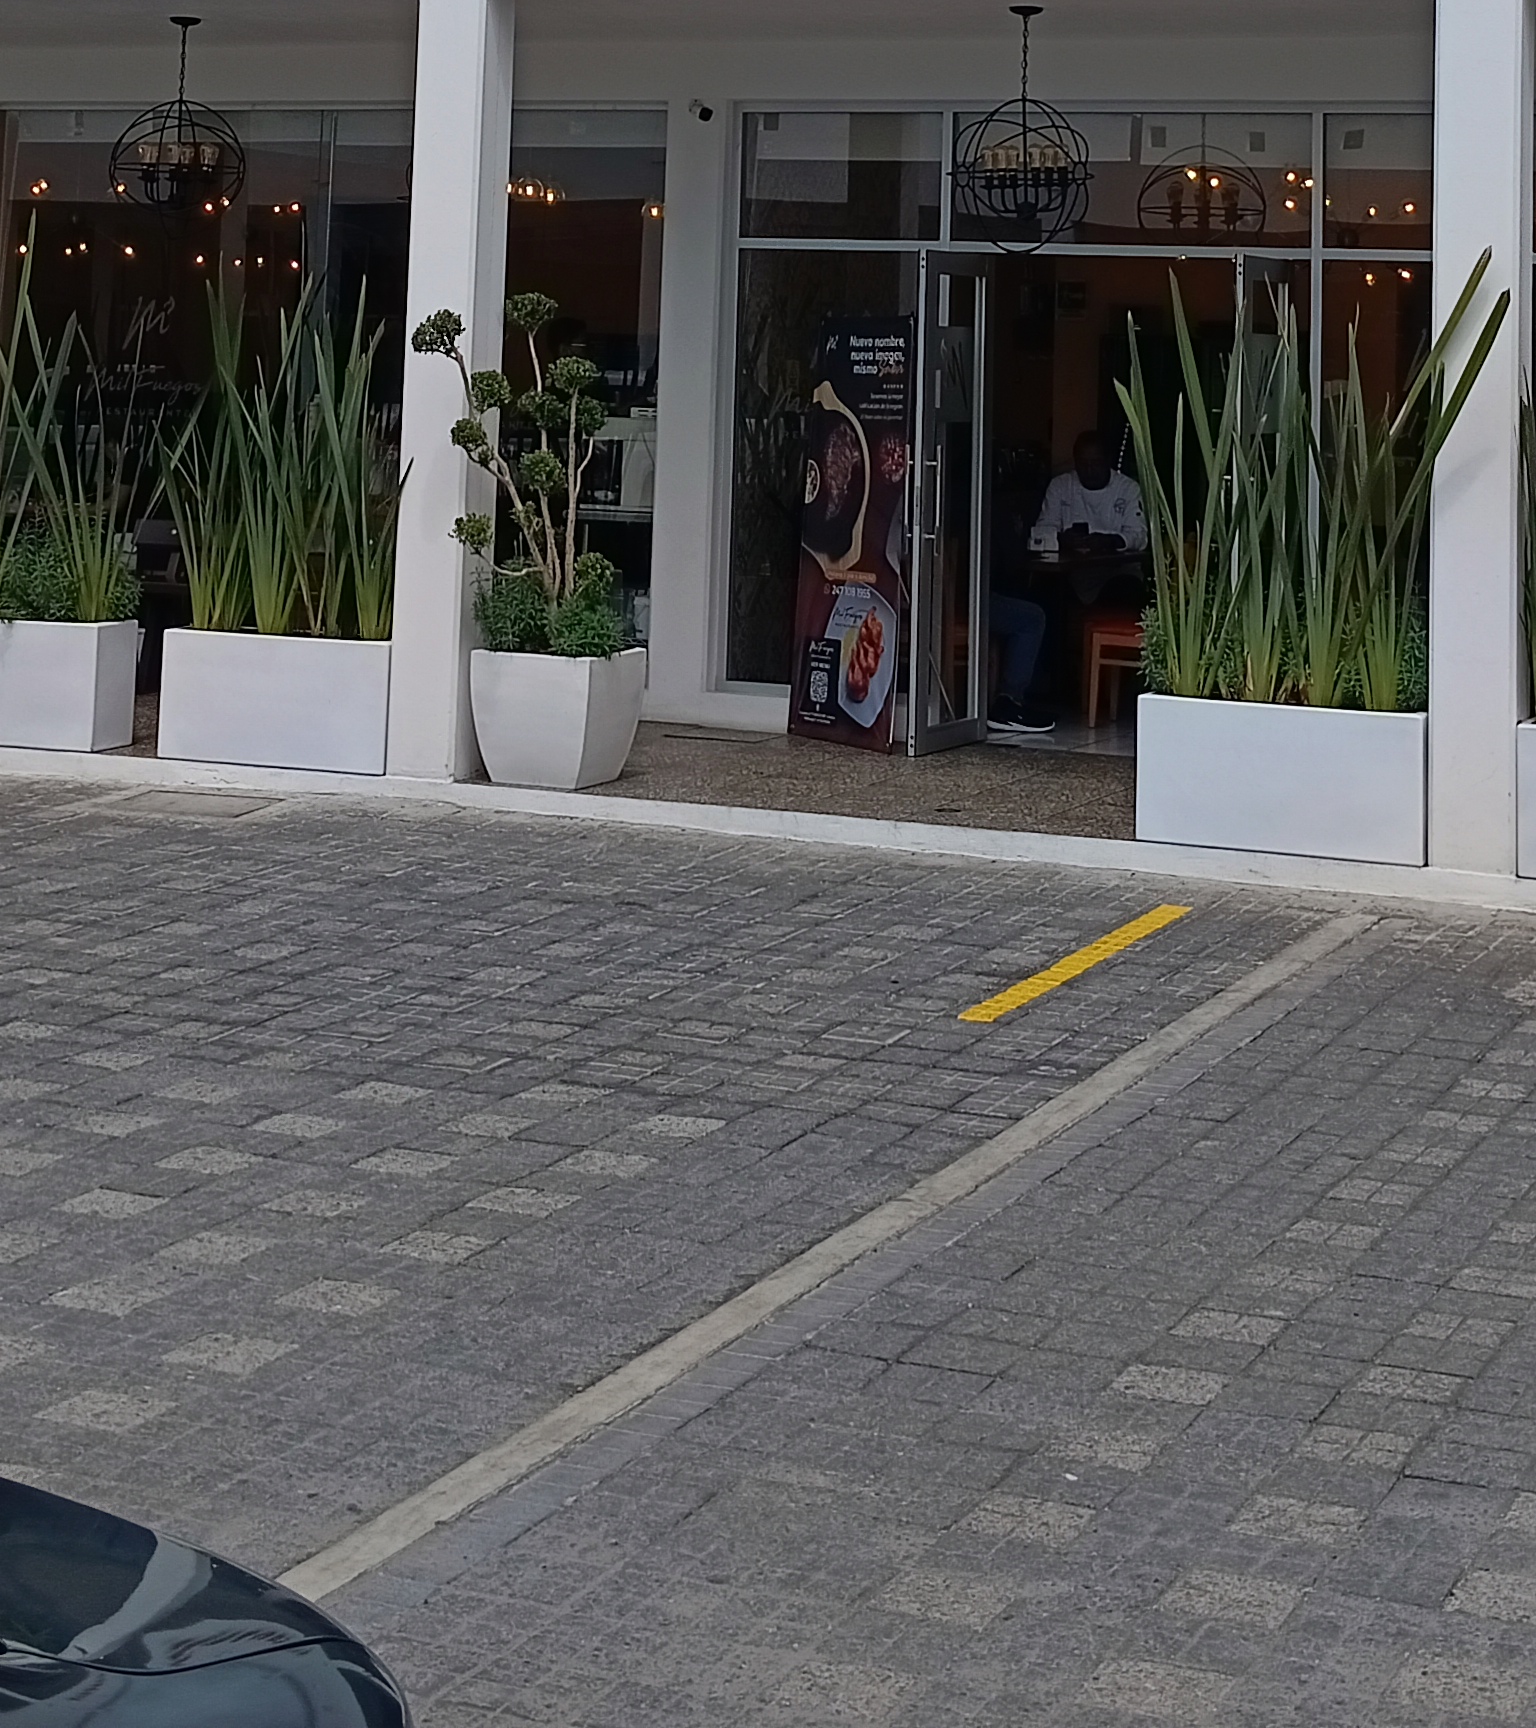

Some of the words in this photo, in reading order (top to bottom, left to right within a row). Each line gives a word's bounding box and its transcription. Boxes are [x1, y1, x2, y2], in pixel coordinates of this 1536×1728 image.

[849, 334, 873, 347] Nuevo
[850, 351, 873, 361] nueva
[853, 361, 878, 375] mismo
